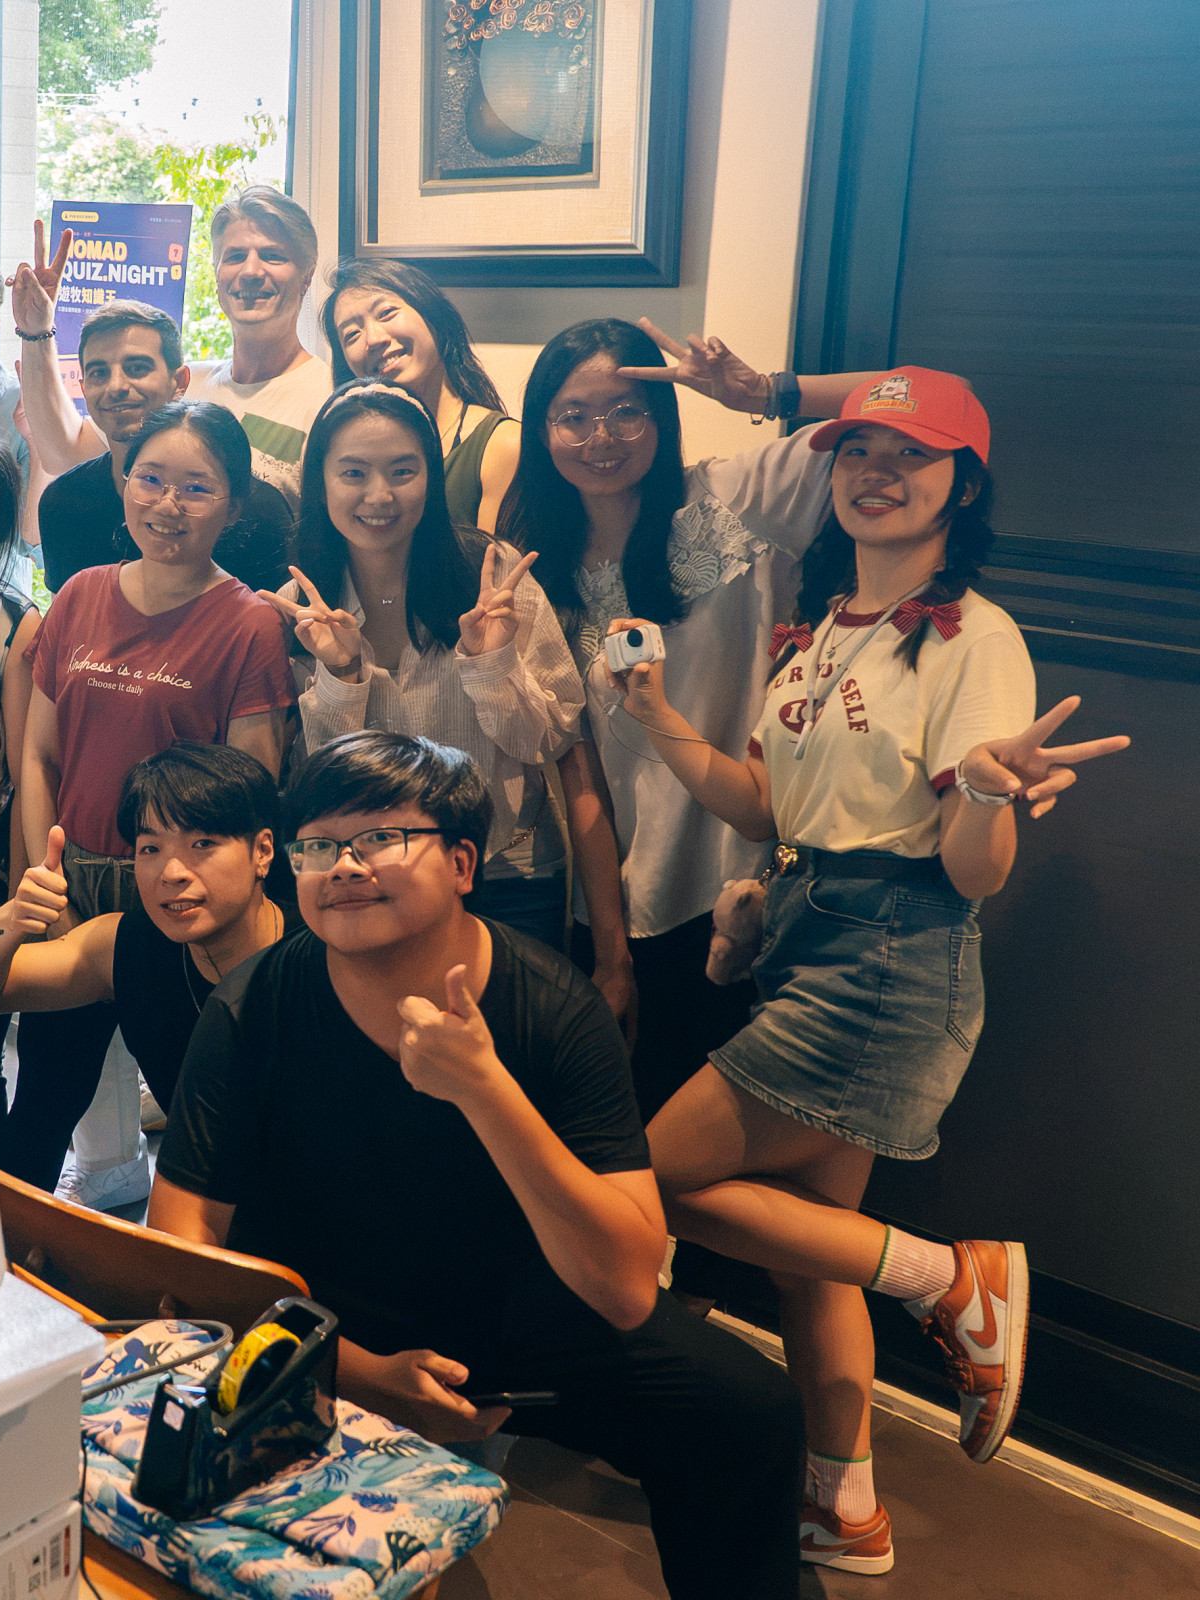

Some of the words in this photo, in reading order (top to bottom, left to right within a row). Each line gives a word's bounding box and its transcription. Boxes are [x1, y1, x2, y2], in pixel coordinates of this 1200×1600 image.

[87, 677, 117, 690] Choose
[118, 682, 125, 691] it
[125, 684, 144, 696] daily
[117, 662, 131, 676] is
[133, 669, 144, 679] a
[147, 662, 193, 689] choice
[816, 662, 870, 734] YOSELF
